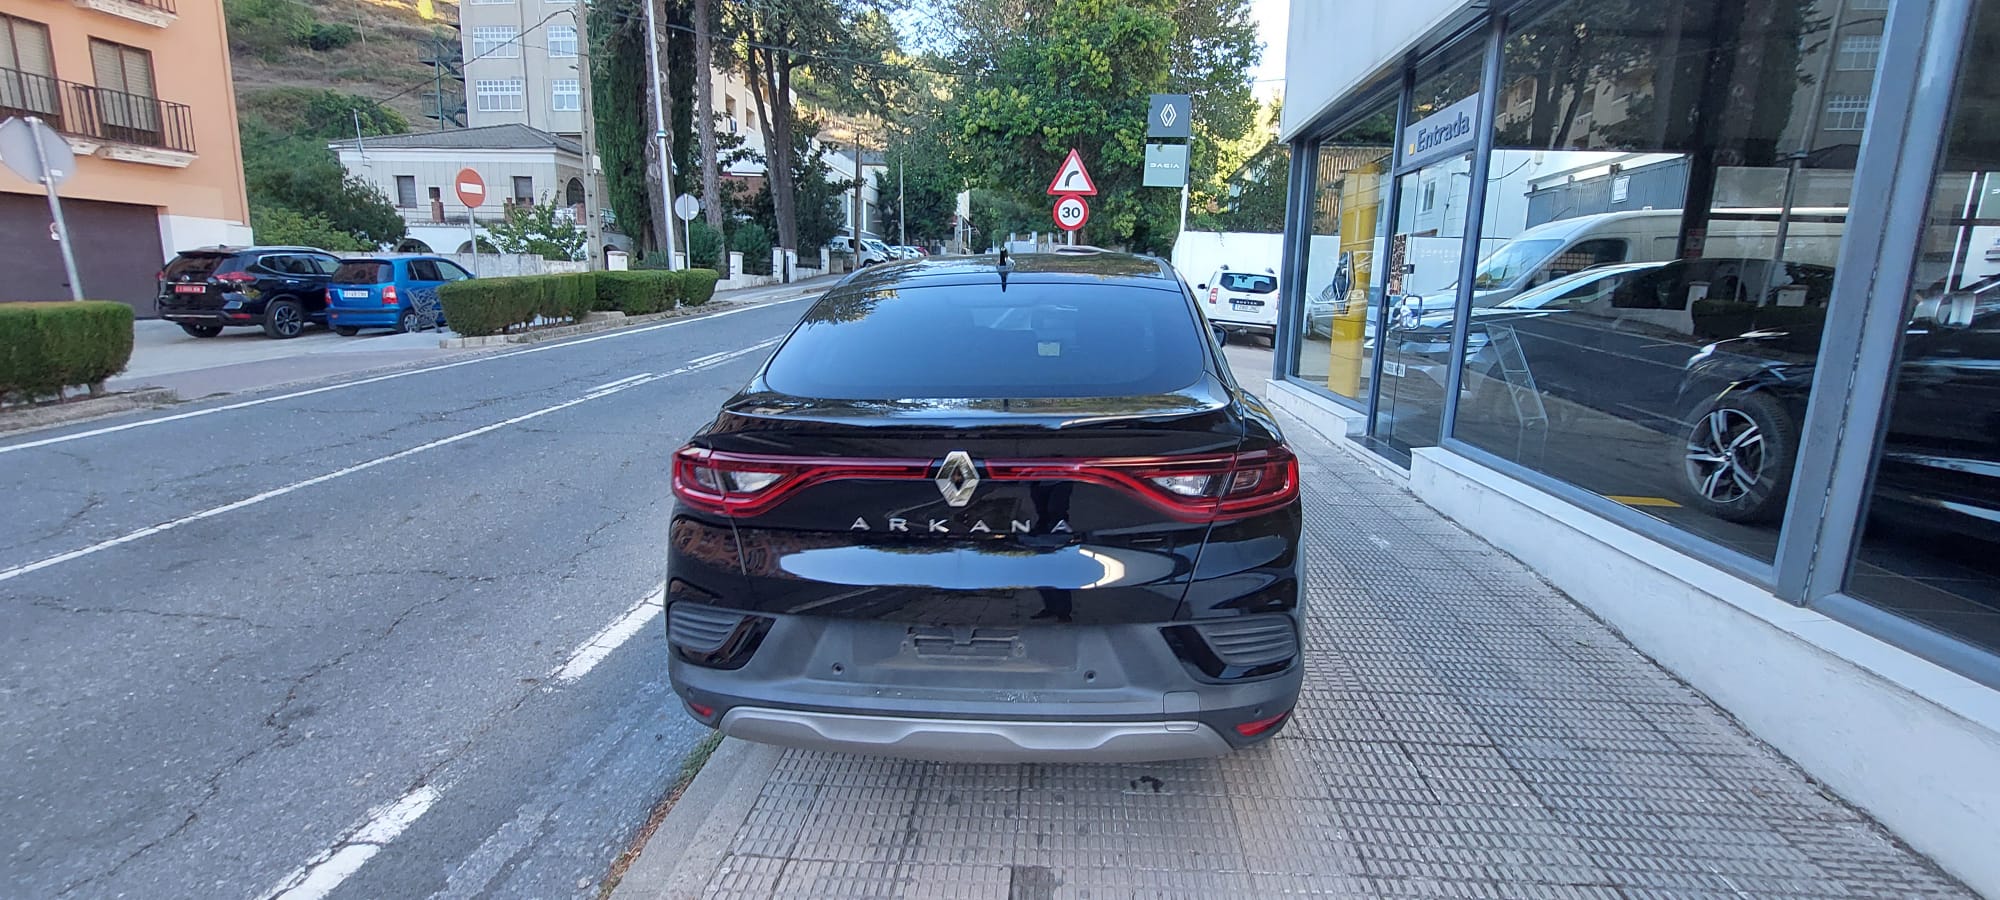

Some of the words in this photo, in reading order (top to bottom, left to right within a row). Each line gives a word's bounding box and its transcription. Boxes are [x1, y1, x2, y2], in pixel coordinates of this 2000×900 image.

[1416, 112, 1470, 152] Entrada
[1062, 206, 1081, 218] 30
[850, 516, 1073, 534] ARKANA
